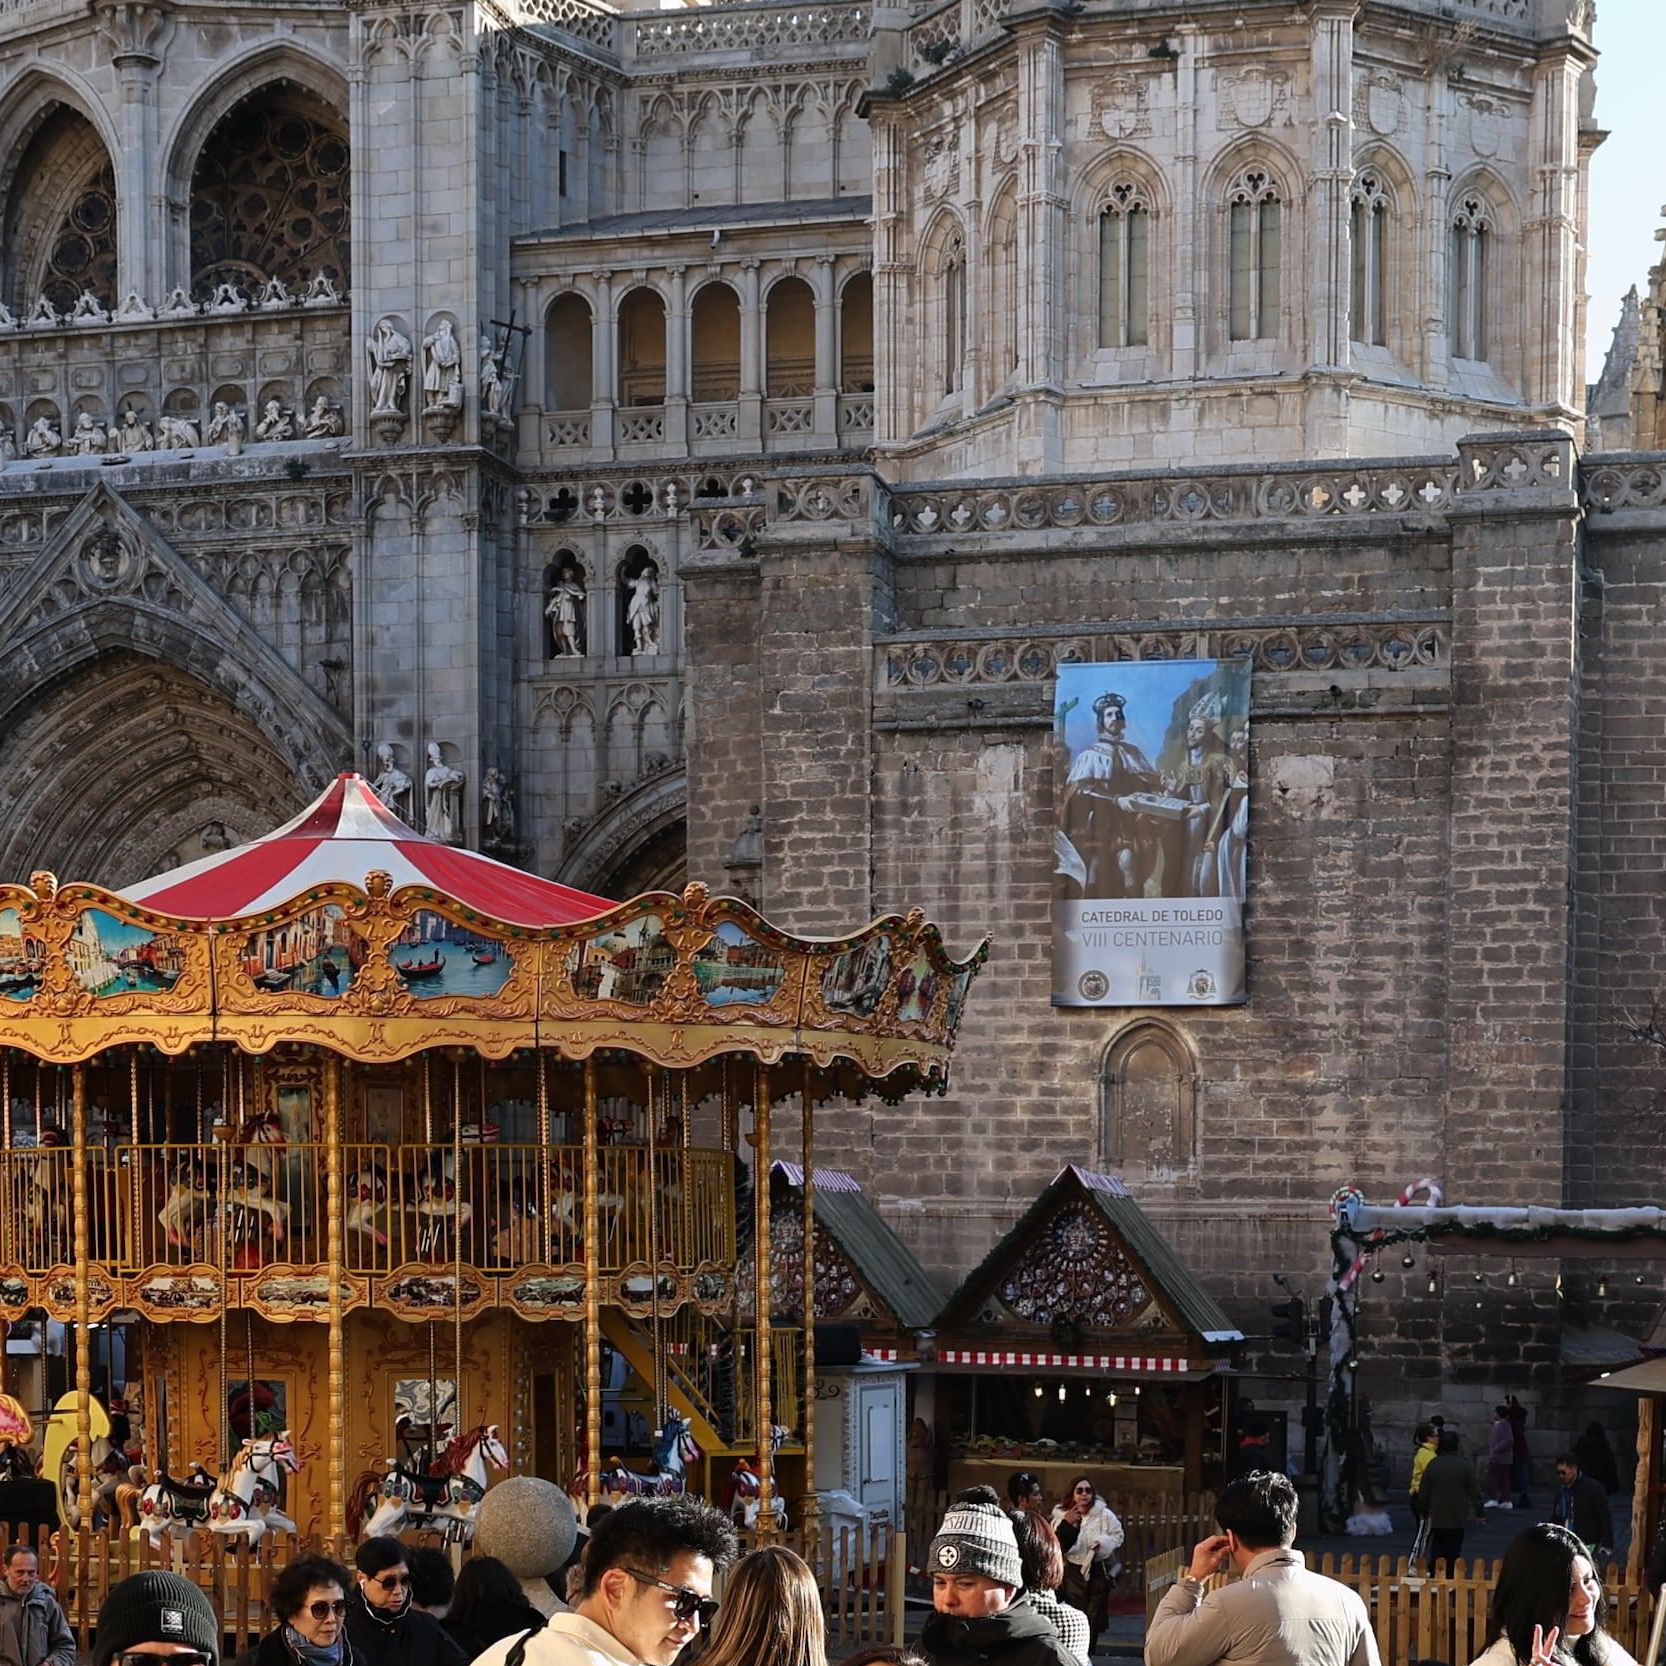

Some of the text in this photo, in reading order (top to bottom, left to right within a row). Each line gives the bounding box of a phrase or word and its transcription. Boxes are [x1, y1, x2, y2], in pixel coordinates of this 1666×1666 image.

[1081, 909, 1224, 923] CATEDRAL DE TOLEDO
[1082, 930, 1224, 947] VIII CENTENARIO
